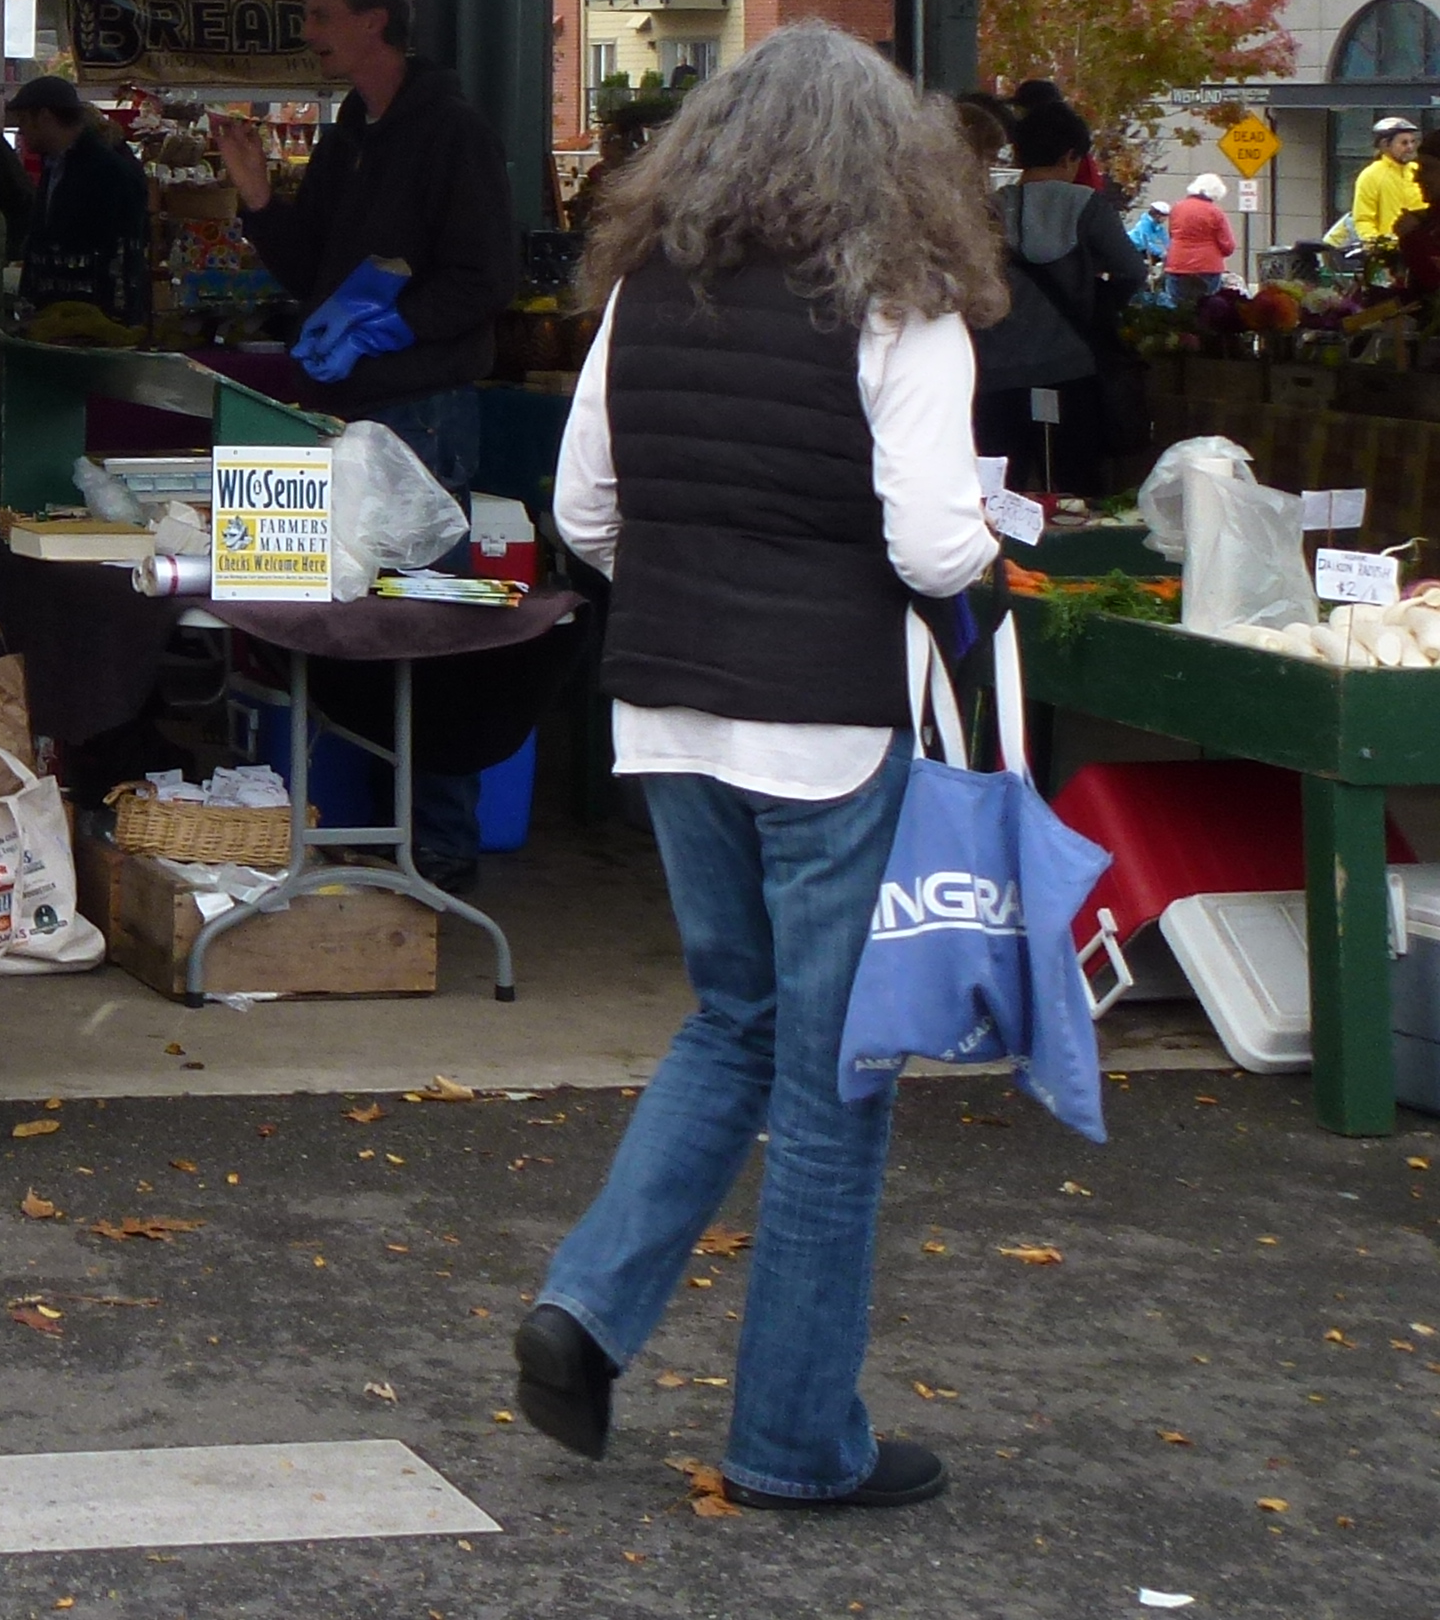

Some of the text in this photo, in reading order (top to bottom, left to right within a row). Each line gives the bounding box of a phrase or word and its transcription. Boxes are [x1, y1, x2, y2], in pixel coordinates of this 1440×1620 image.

[1233, 131, 1265, 143] DEAD
[1237, 148, 1262, 160] END
[217, 469, 256, 508] WIC
[263, 469, 328, 509] Senior
[260, 518, 328, 534] FARMERS
[260, 537, 328, 552] MARKET
[219, 554, 326, 572] Checks Welcome Here
